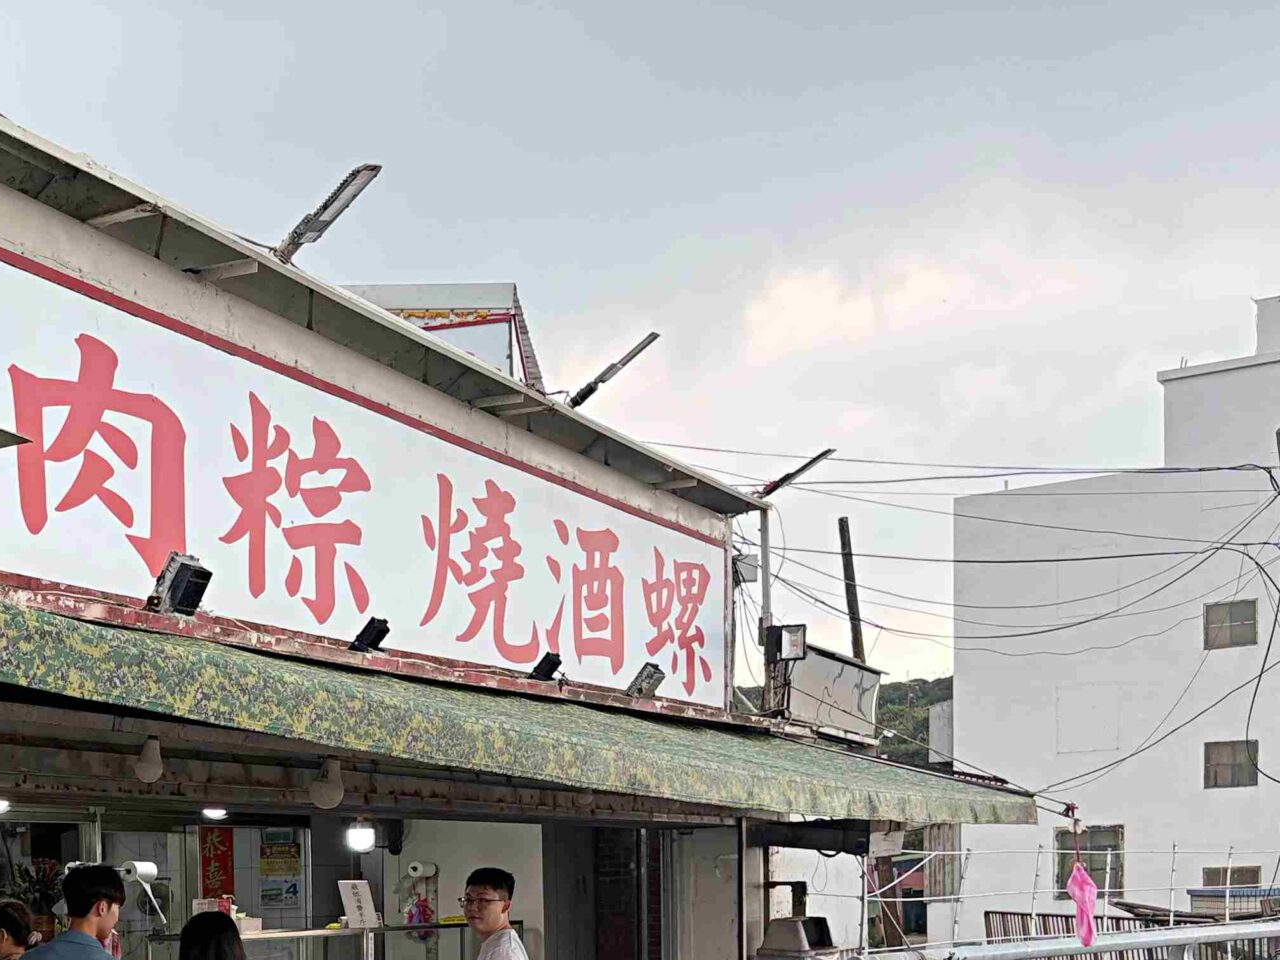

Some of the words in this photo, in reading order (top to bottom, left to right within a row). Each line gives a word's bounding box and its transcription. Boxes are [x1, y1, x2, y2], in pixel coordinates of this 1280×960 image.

[420, 470, 710, 697] 燒酒螺
[285, 883, 299, 896] 4
